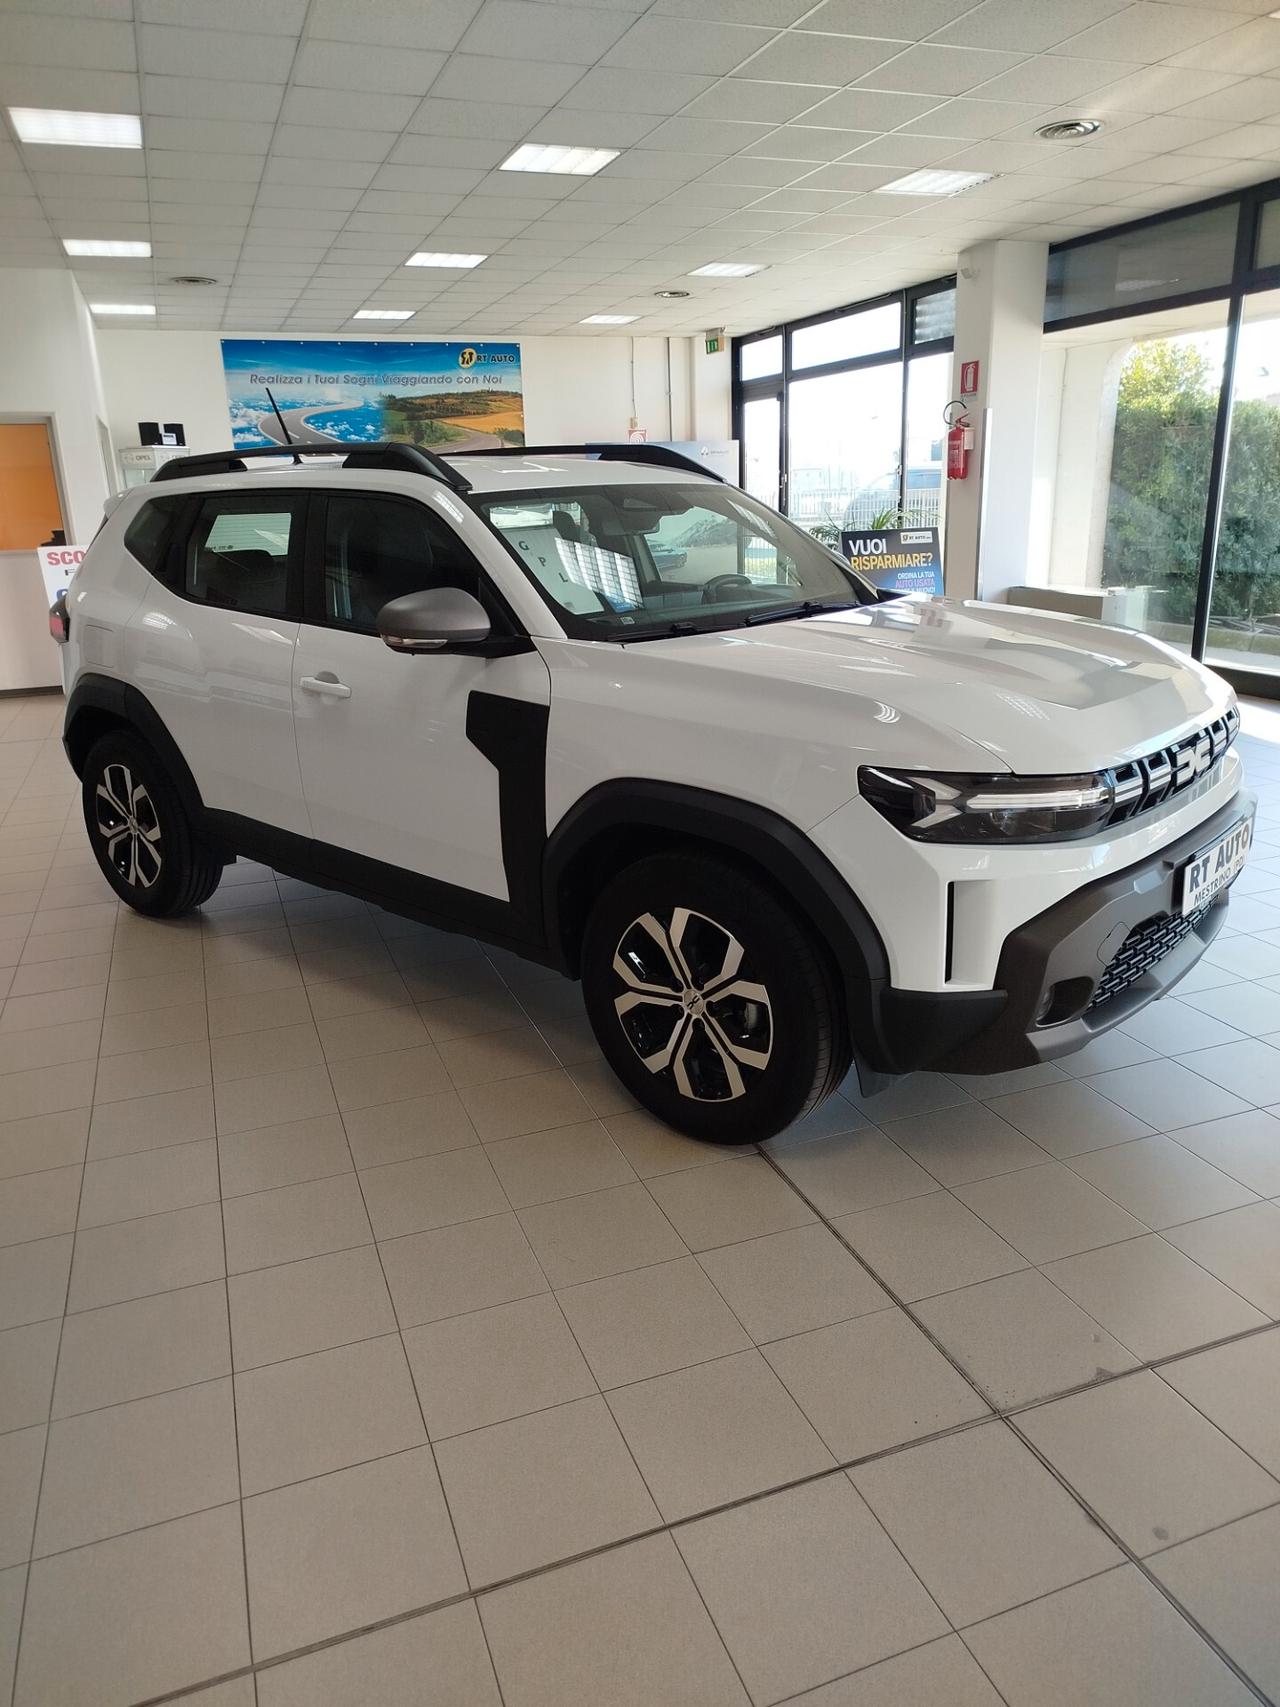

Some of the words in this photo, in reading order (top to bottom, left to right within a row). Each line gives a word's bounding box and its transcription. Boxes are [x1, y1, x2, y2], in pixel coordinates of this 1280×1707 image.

[476, 354, 488, 362] RT
[490, 354, 515, 363] AUTO
[250, 374, 303, 384] Realizza
[314, 374, 340, 384] Tuoi
[343, 374, 378, 386] Sogni
[382, 374, 452, 387] Viaggiando
[456, 376, 479, 385] con
[482, 374, 503, 385] Noi
[849, 538, 887, 555] VUOI
[47, 551, 85, 565] SCO
[851, 552, 933, 570] RISPARMIARE?
[896, 579, 914, 588] AUTO
[914, 578, 935, 587] USATA
[1190, 855, 1211, 893] RT
[1215, 823, 1250, 874] AUTO
[1194, 867, 1231, 906] MESTRINO
